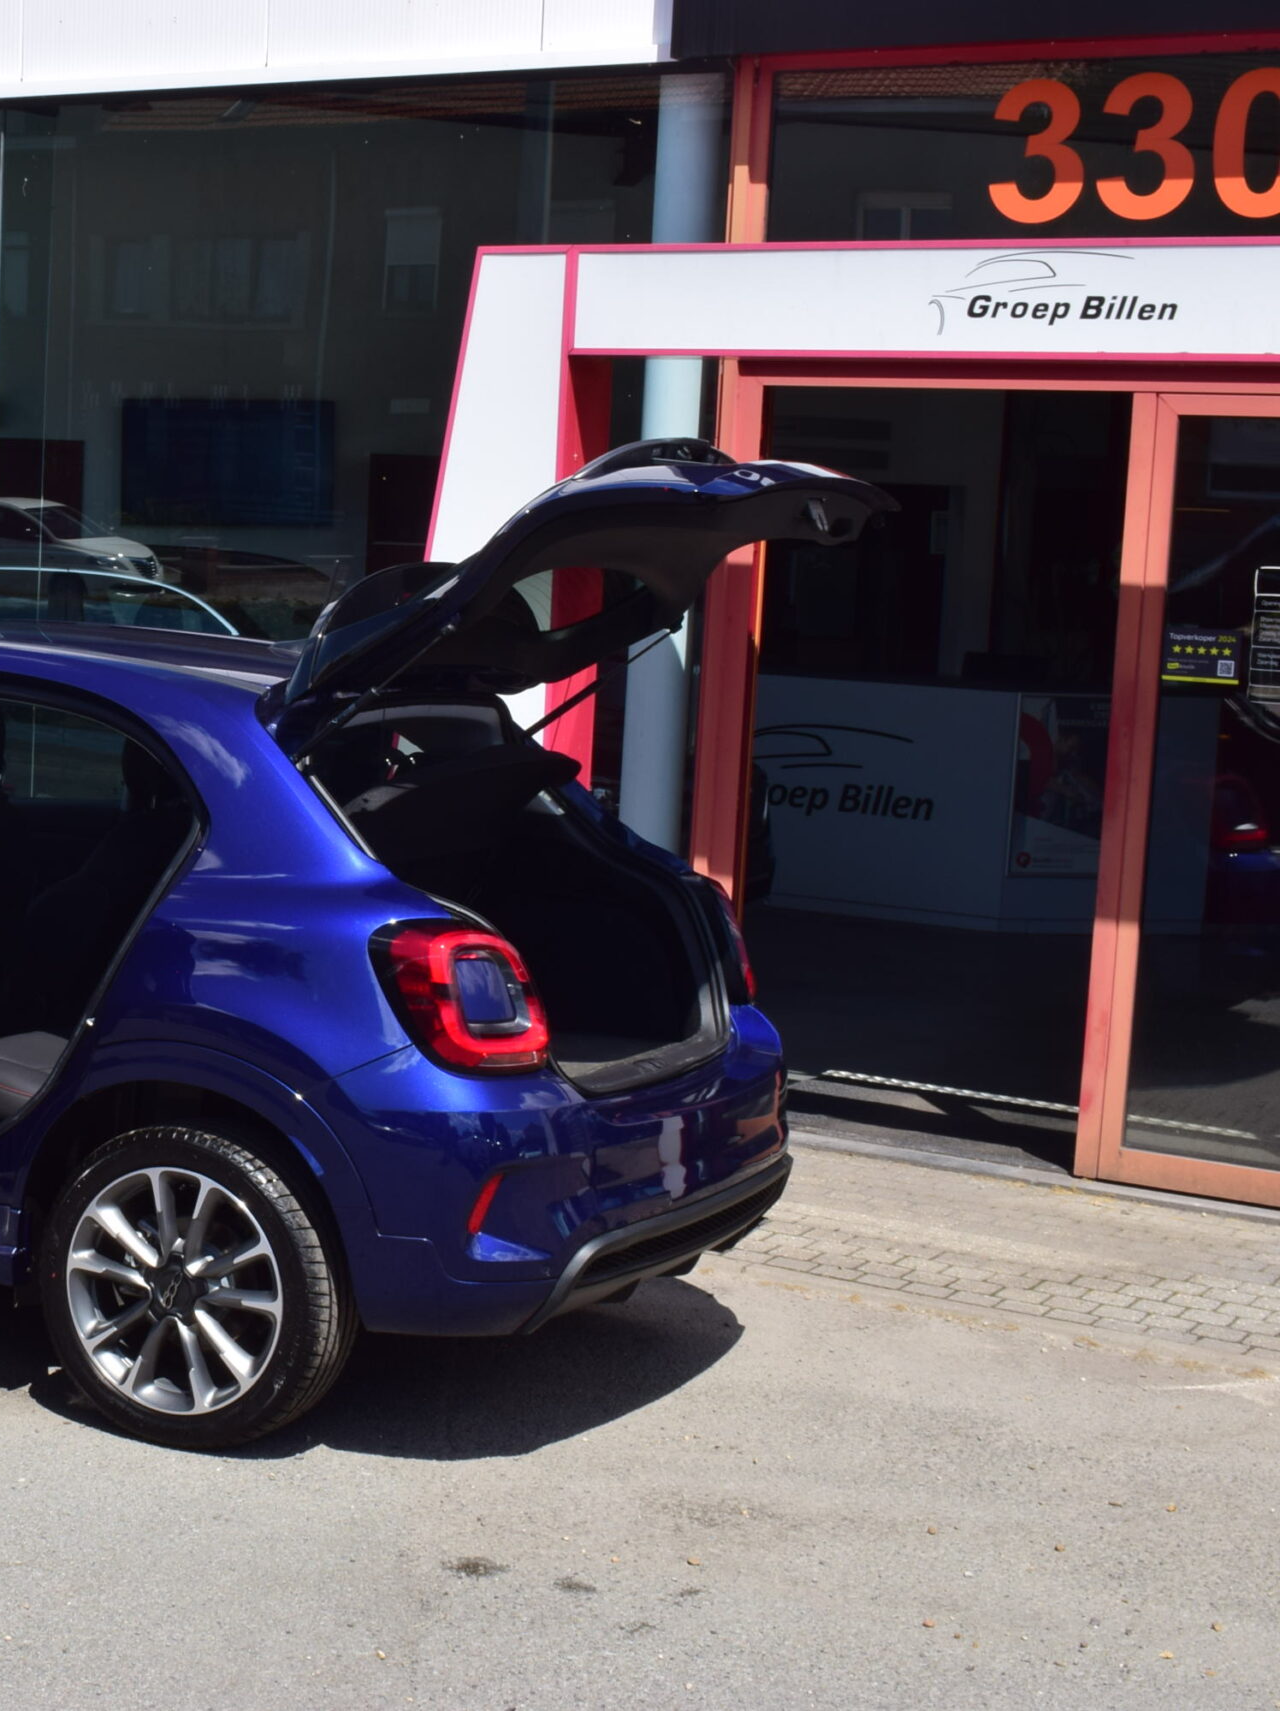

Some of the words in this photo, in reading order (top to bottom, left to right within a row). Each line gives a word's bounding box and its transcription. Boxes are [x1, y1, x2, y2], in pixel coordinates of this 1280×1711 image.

[988, 67, 1280, 224] 330
[967, 294, 1071, 326] Groep
[1079, 295, 1178, 321] Billen
[766, 783, 829, 816] oep
[838, 784, 935, 821] Billen
